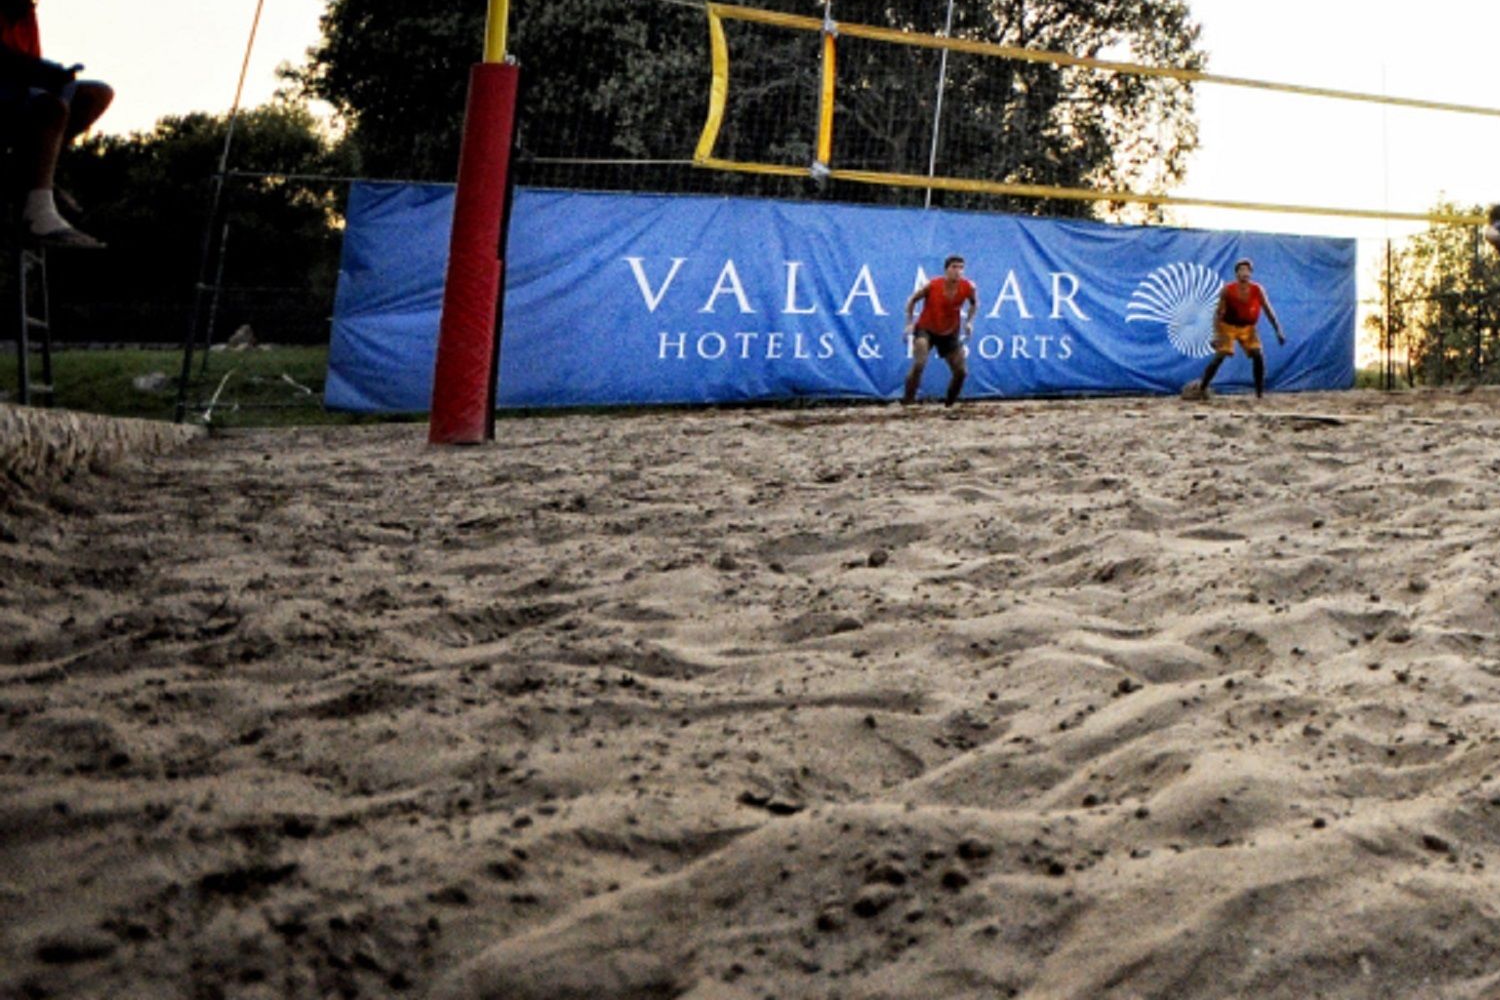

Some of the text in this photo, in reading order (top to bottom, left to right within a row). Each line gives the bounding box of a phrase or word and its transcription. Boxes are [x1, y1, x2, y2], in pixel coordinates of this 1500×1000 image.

[624, 256, 1091, 321] VALAAR
[659, 332, 834, 359] HOTELS
[857, 335, 883, 359] &
